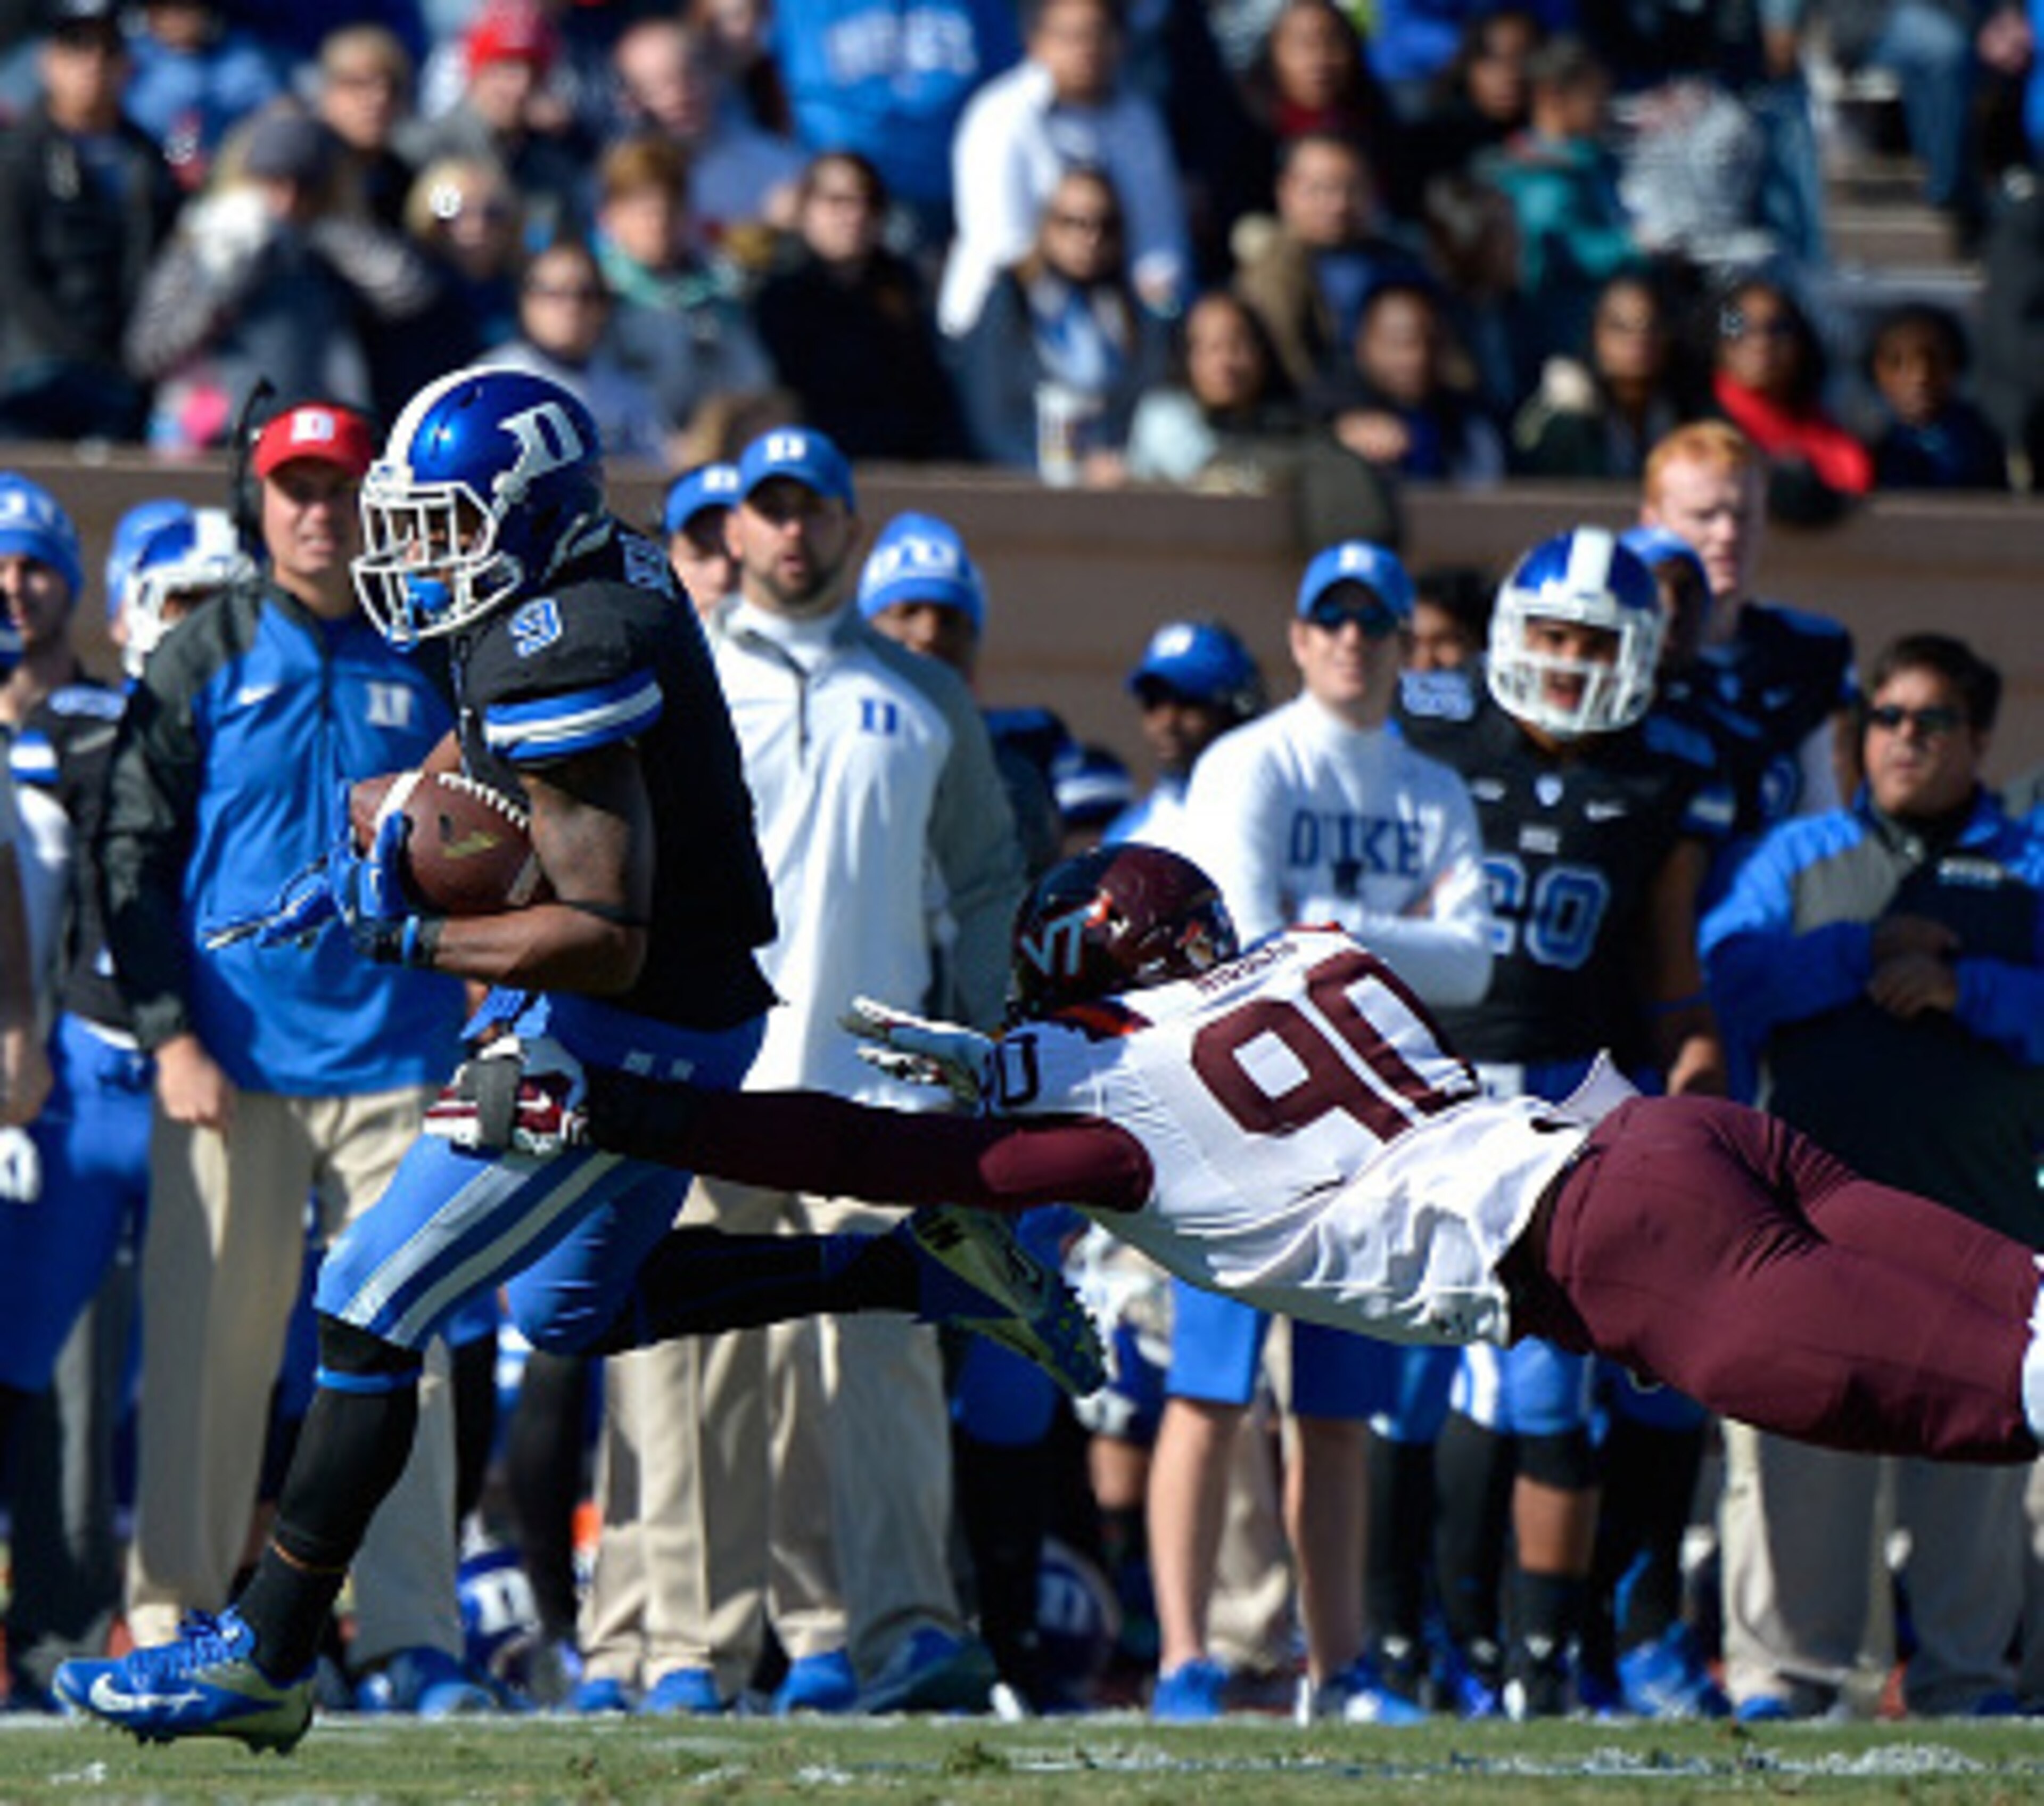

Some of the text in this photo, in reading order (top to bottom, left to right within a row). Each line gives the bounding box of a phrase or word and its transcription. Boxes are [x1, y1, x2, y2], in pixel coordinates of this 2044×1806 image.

[292, 409, 334, 441] D
[767, 432, 805, 462] D
[1288, 809, 1422, 877] DUKE
[1190, 949, 1482, 1145] 90
